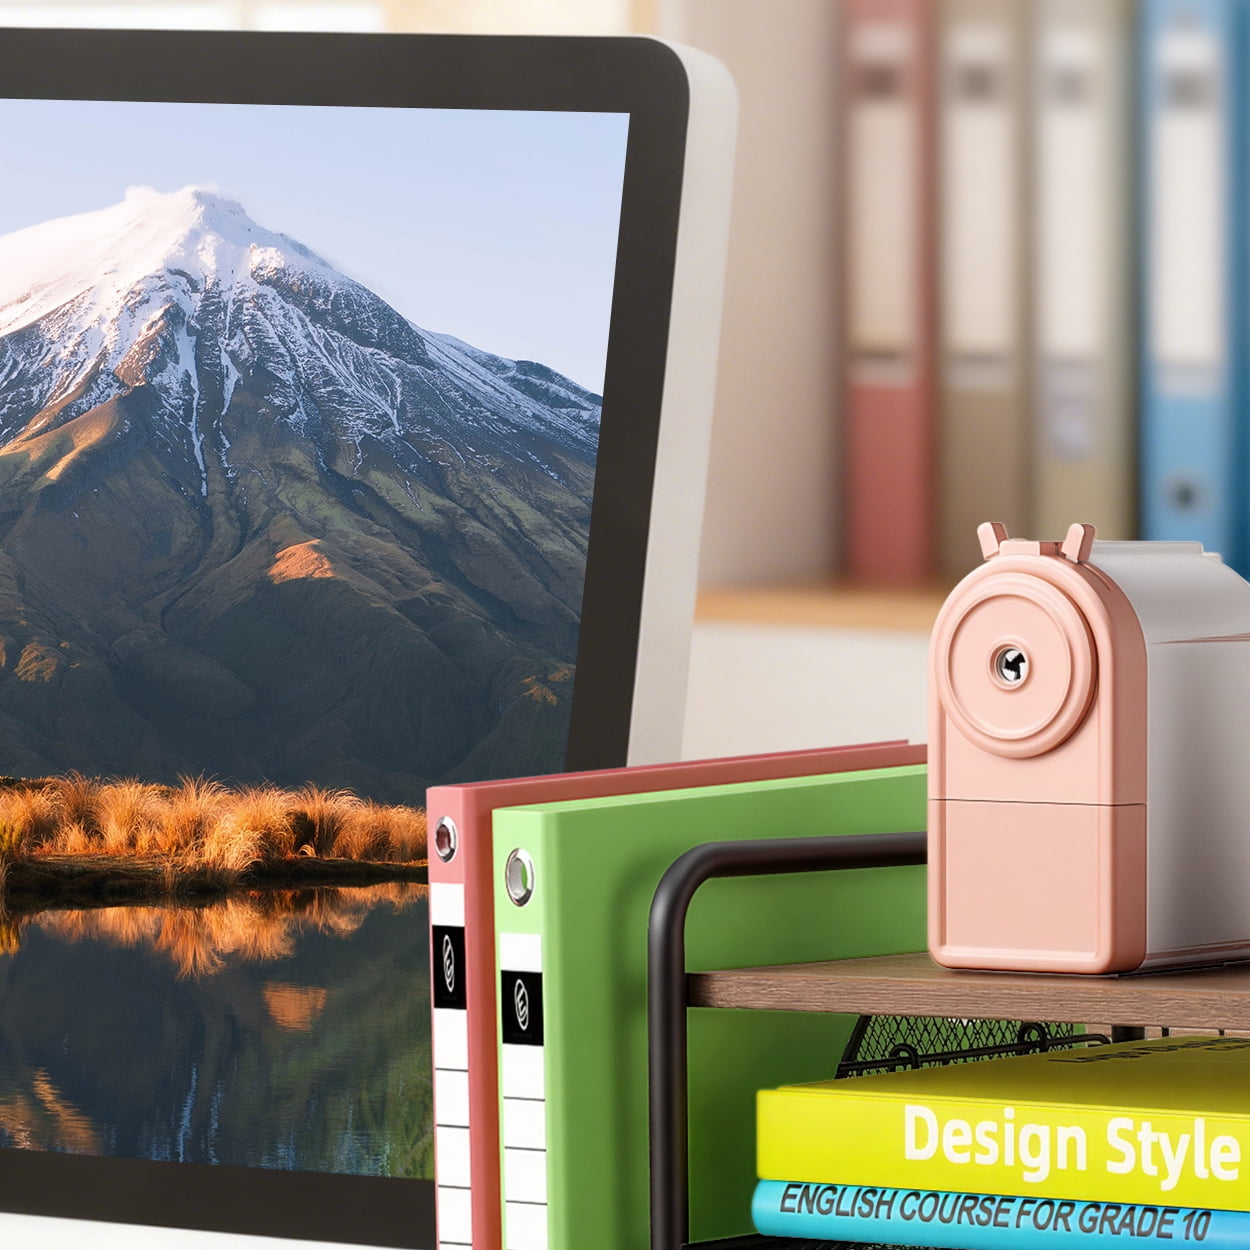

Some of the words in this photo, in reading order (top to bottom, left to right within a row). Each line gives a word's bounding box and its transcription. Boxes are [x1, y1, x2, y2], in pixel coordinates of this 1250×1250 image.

[904, 1105, 1087, 1183] Design
[1106, 1116, 1241, 1190] Style
[780, 1184, 899, 1220] ENGLISH
[899, 1191, 1017, 1228] COURSE
[1015, 1200, 1079, 1231] FOR
[1077, 1203, 1179, 1239] GRADE
[1181, 1209, 1211, 1241] 10
